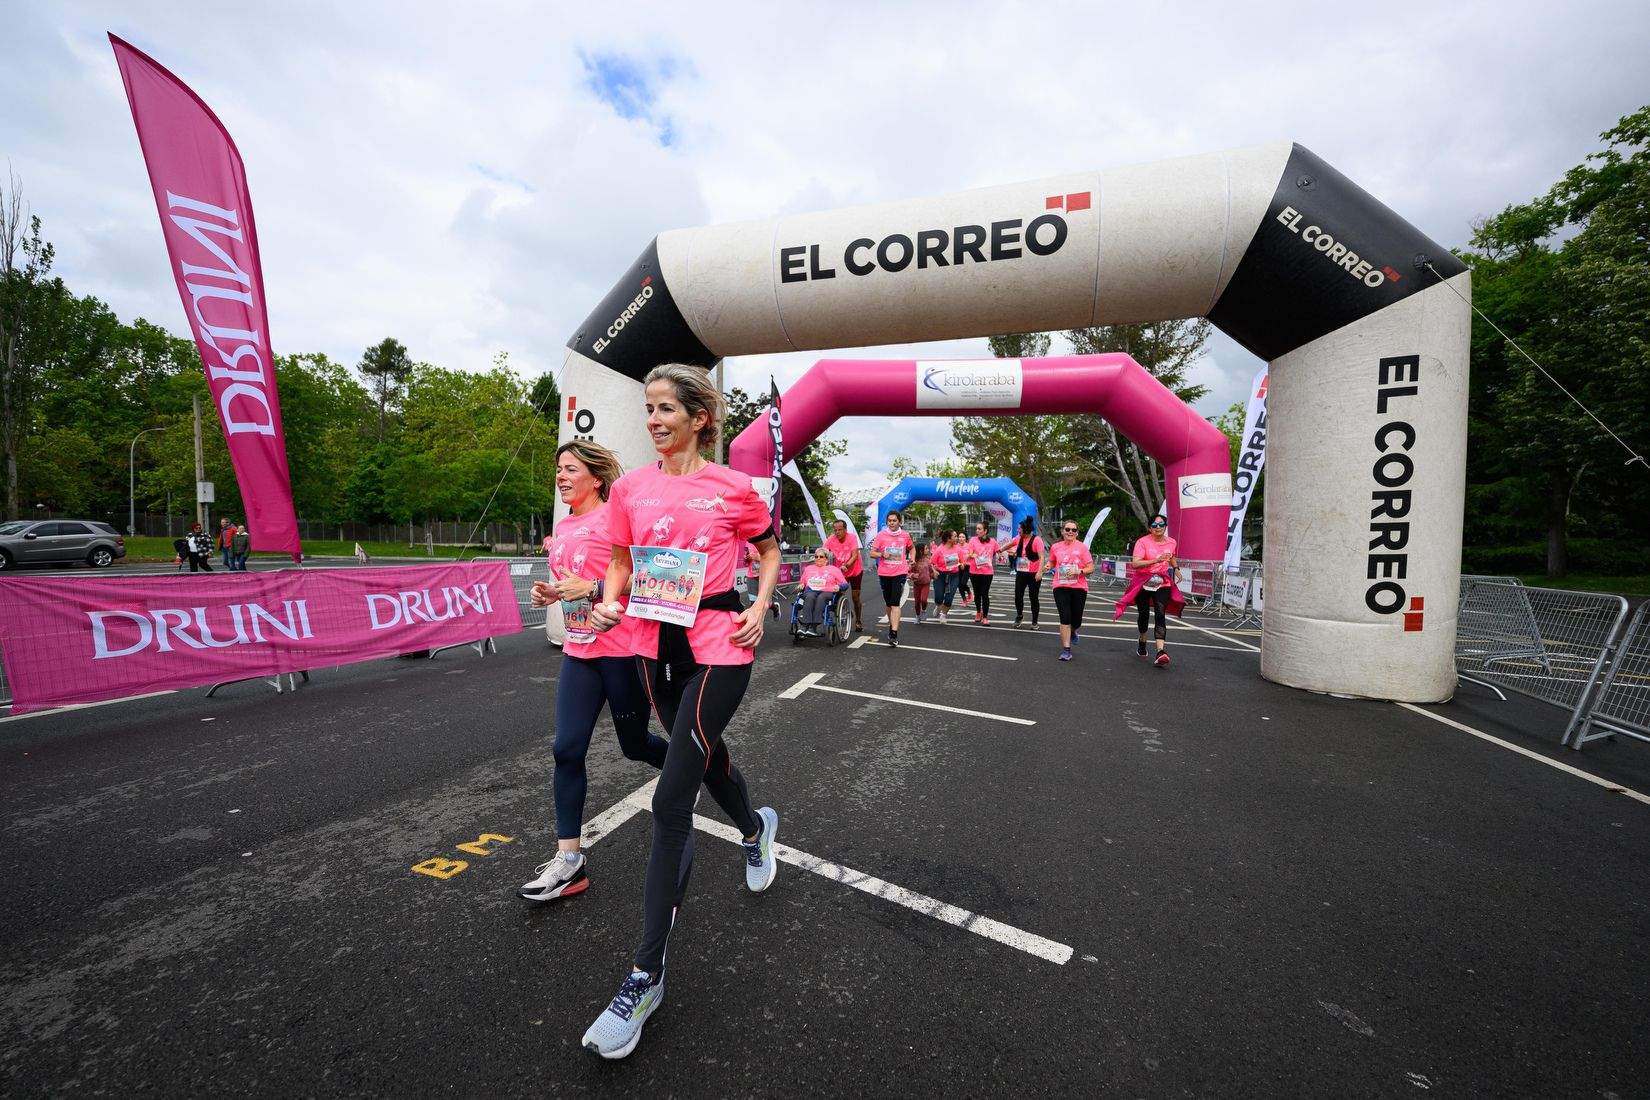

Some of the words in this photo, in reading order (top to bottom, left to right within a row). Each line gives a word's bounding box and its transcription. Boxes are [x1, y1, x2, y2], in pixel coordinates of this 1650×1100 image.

[781, 245, 836, 284] EL
[844, 214, 1068, 277] CORREO
[1276, 205, 1303, 234] EL
[1302, 225, 1385, 288] CORREO
[592, 337, 611, 354] EL
[607, 285, 654, 338] CORREO
[944, 372, 1015, 387] kirolaraba
[1376, 354, 1420, 414] EL
[1231, 398, 1268, 512] CORRE
[1365, 421, 1416, 615] CORREO
[87, 599, 315, 660] DRUNI
[365, 584, 494, 630] DRUNI
